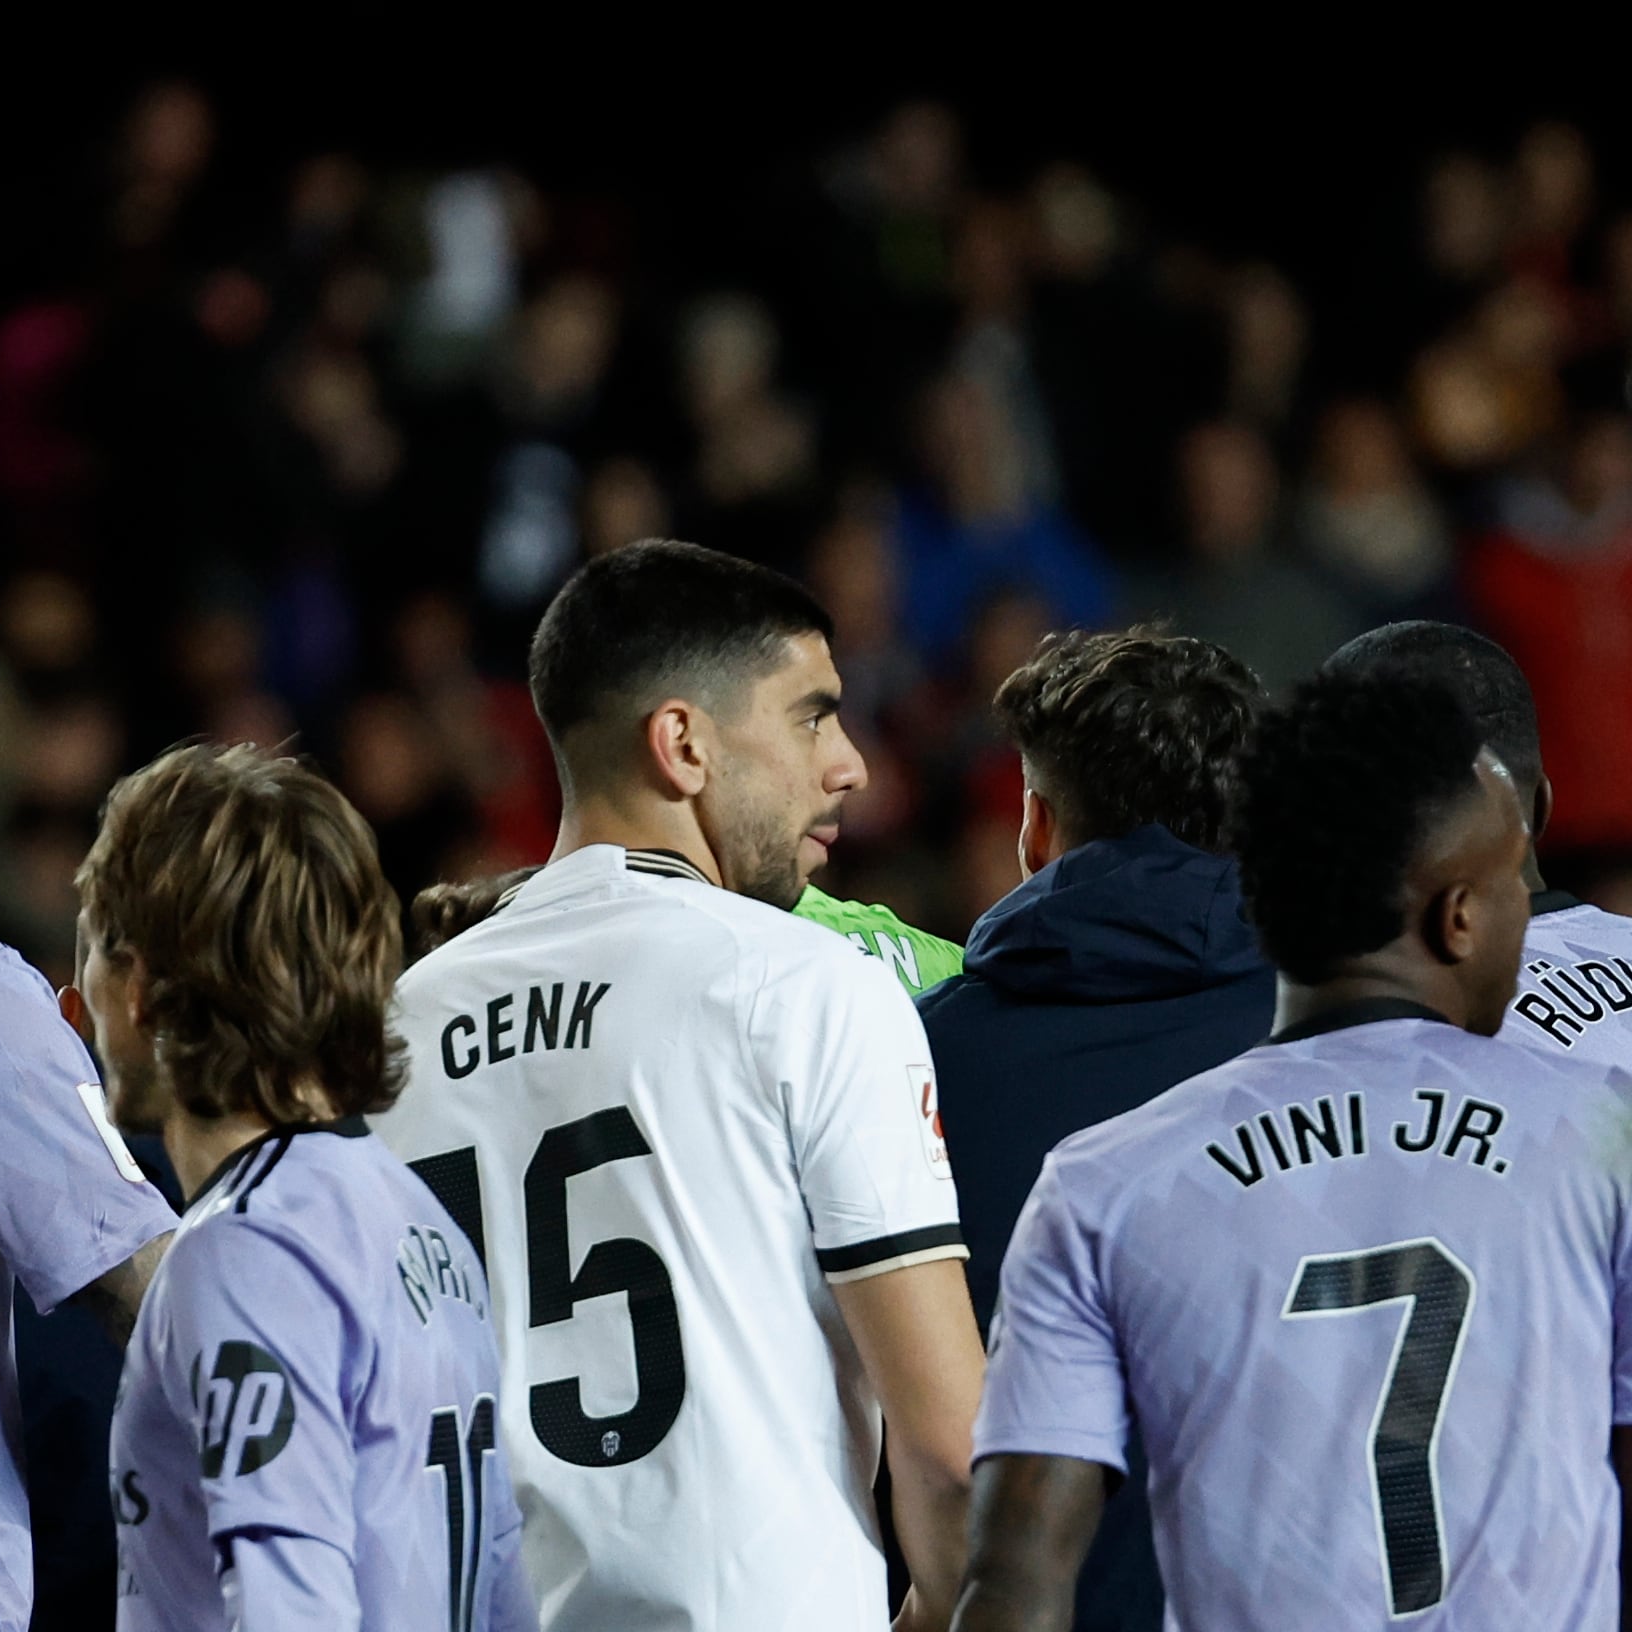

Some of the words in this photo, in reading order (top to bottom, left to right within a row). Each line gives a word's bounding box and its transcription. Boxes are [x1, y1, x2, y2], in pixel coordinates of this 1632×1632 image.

[440, 981, 613, 1080] CENK
[1205, 1092, 1366, 1188] VINI
[1392, 1088, 1509, 1174] JR.
[192, 1341, 293, 1480] hp
[1280, 1236, 1476, 1620] 7
